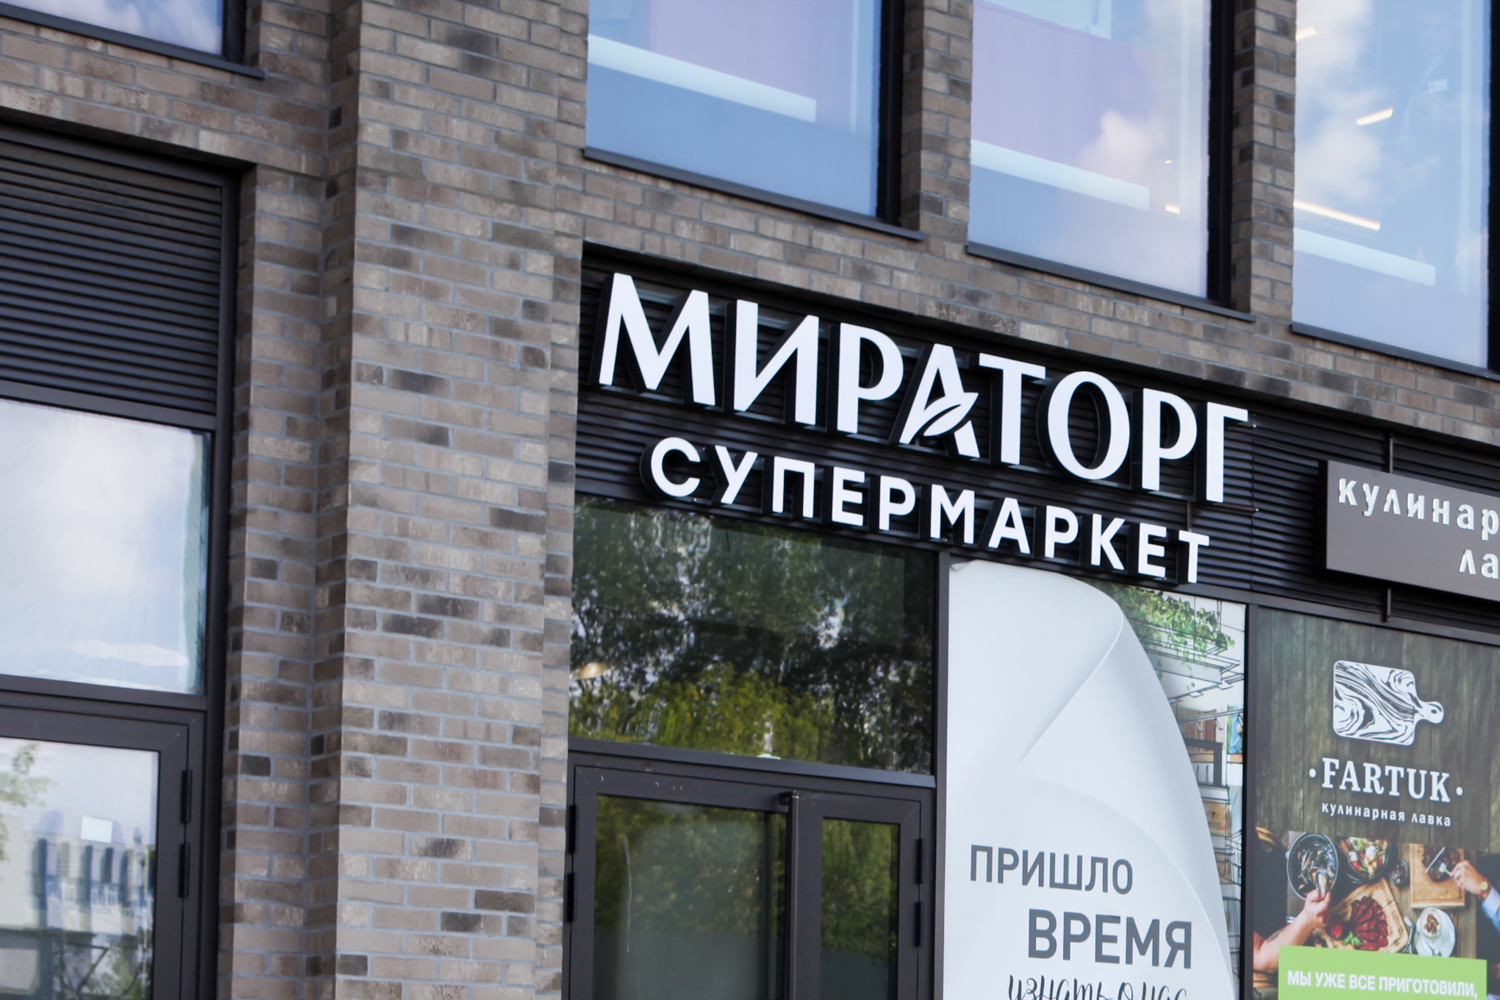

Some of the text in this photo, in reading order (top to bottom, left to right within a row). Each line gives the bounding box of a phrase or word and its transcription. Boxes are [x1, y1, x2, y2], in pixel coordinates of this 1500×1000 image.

[598, 272, 1249, 503] МИРАТОРГ
[650, 437, 1210, 584] СУПЕРМАРКЕТ
[1321, 802, 1451, 827] кулинарная лавка
[970, 844, 1133, 895] ПРИШЛО
[1028, 908, 1192, 969] ВРЕМЯ
[1287, 970, 1478, 1000] МЫ УЖЕ ВСЕ ПРИГОТОВИЛИ,
